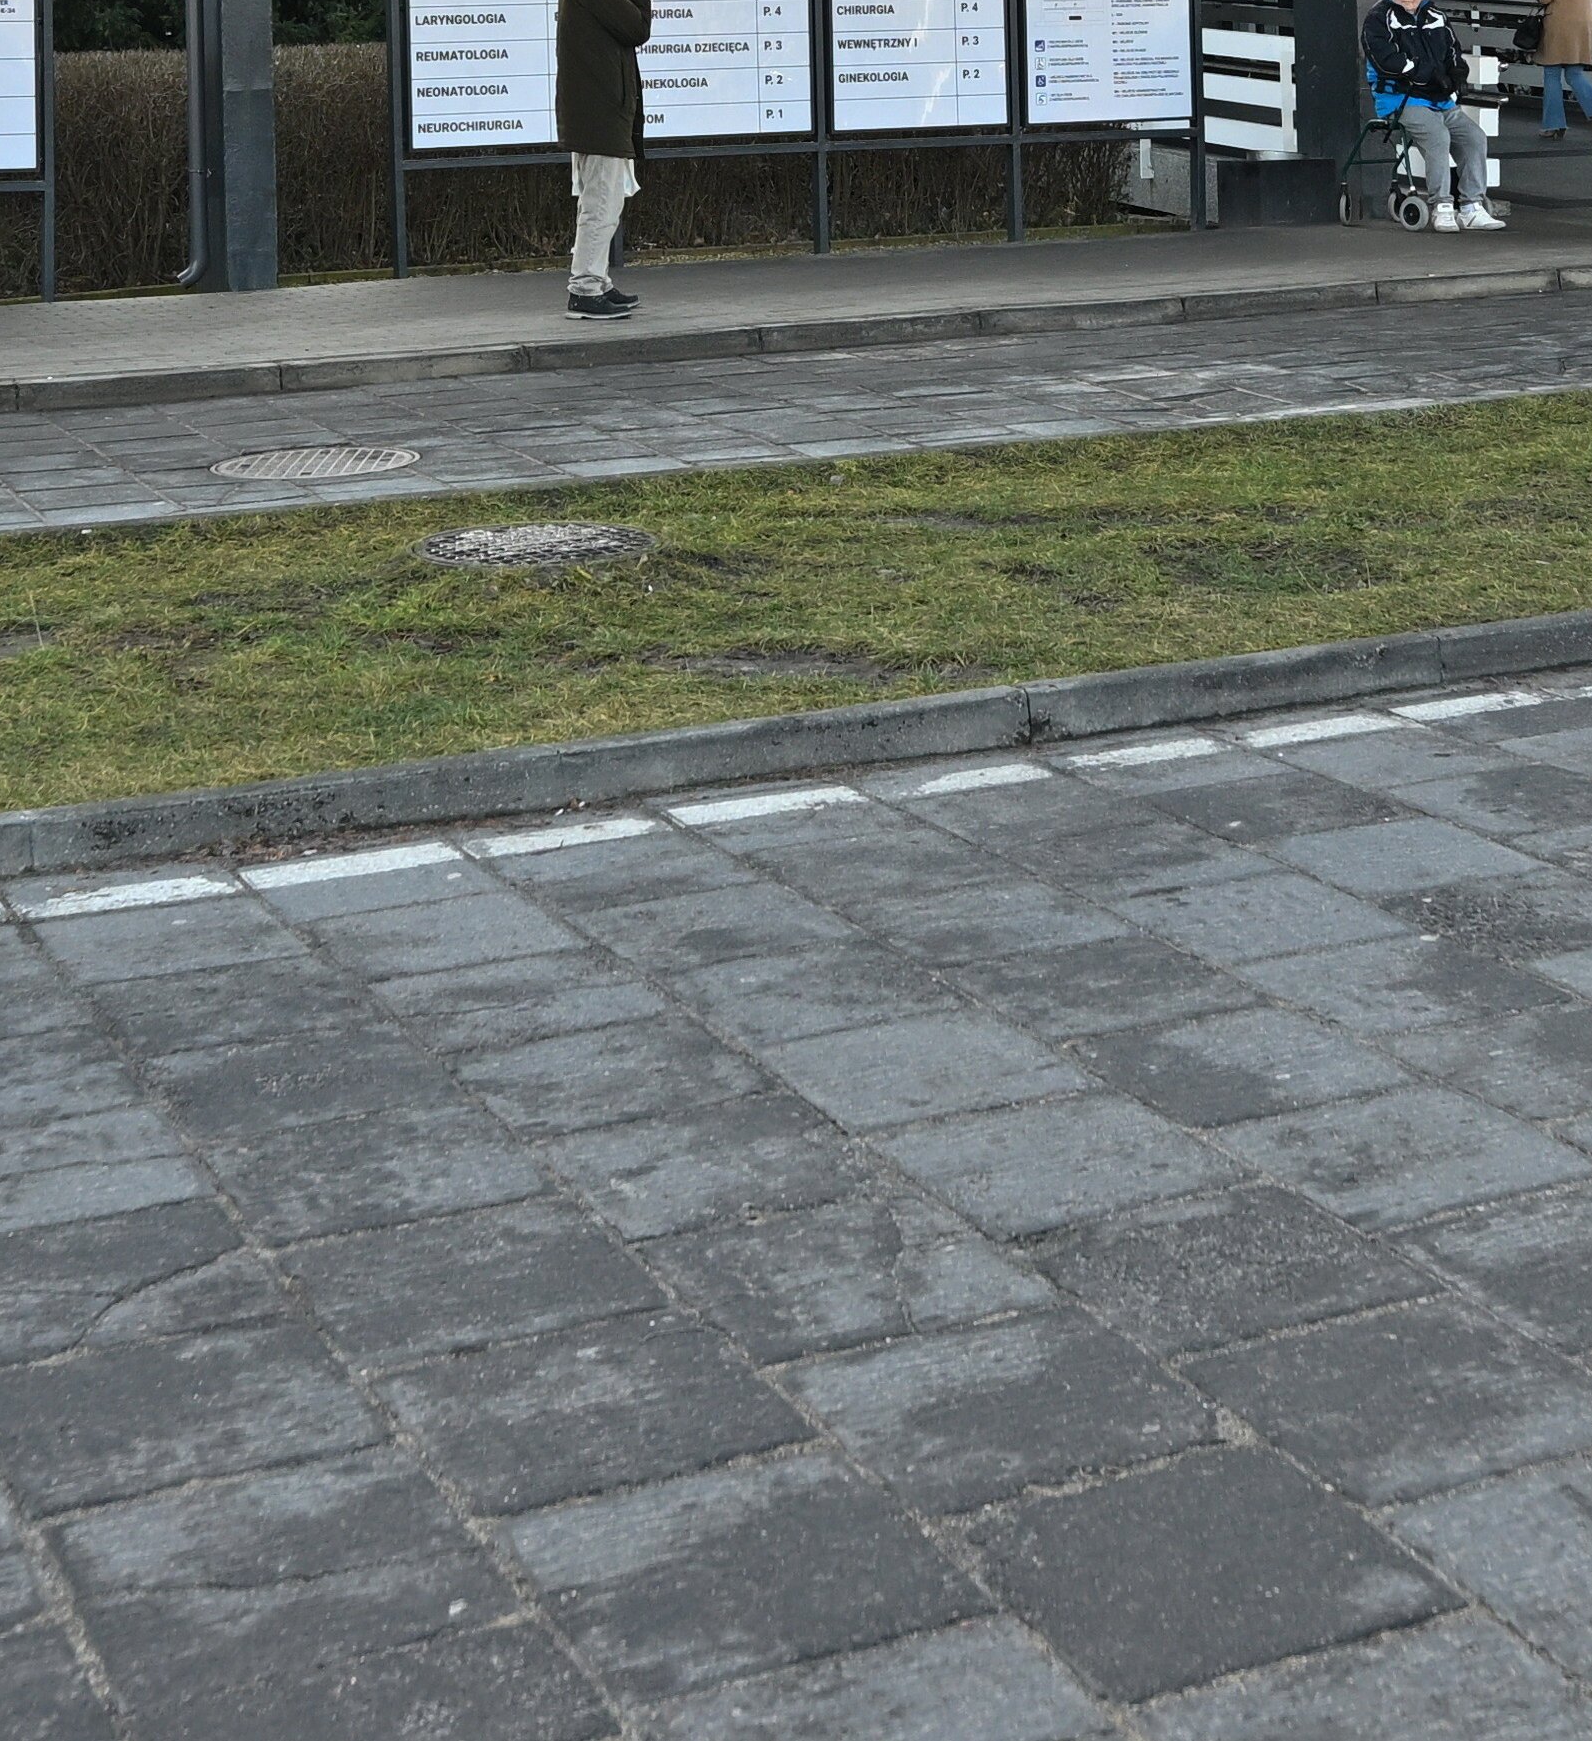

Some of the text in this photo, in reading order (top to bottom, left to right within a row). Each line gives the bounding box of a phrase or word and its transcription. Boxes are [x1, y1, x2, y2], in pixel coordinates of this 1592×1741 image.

[652, 9, 693, 19] RURGIA
[837, 5, 895, 15] CHIRURGIA
[415, 13, 506, 26] LARYNGOLOGIA
[694, 42, 750, 54] DZIECIĘCA
[838, 38, 911, 50] WEWNĘTRZNY
[416, 49, 509, 62] REUMATOLOGIA
[838, 71, 909, 83] GINEKOLOGIA
[641, 78, 708, 89] INEKOLOGIA
[417, 85, 508, 97] NEONATOLOGIA
[418, 119, 523, 133] NEUROCHIRURGIA
